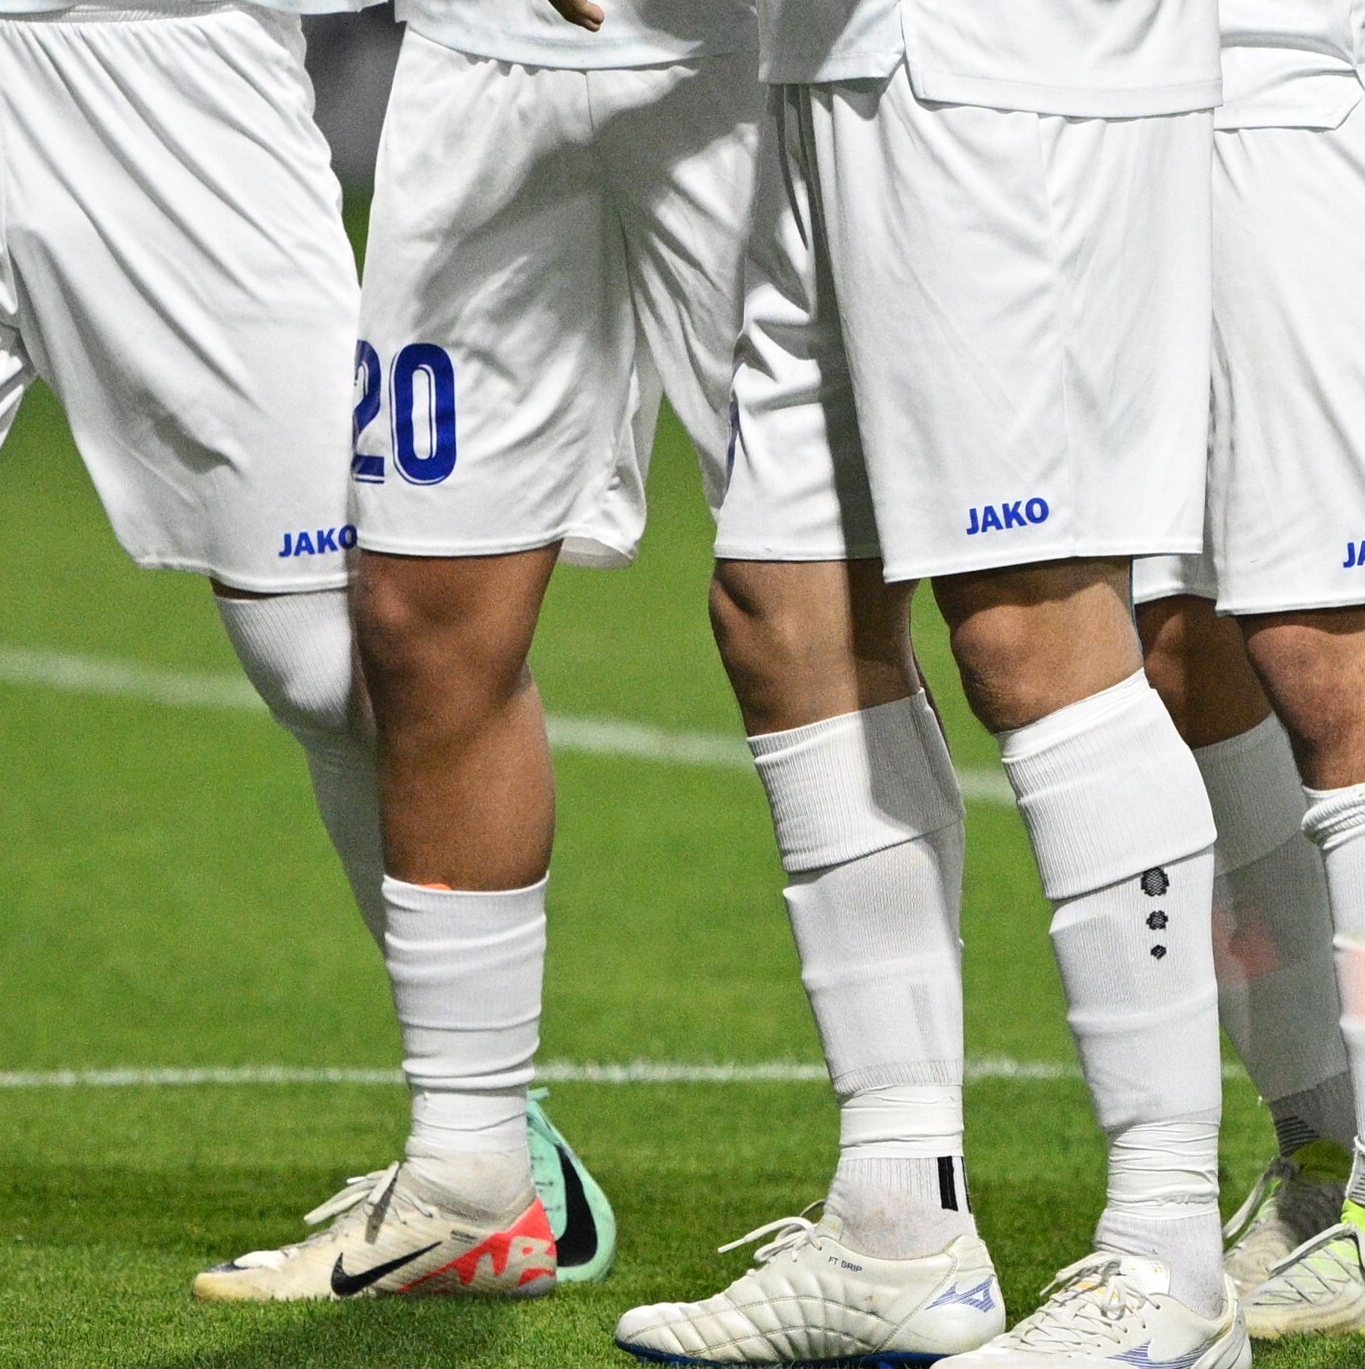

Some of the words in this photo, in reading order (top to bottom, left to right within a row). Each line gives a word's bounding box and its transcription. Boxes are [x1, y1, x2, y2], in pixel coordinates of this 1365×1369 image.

[351, 339, 457, 486] 20
[966, 497, 1050, 535] JAKO
[278, 525, 357, 558] JAKO
